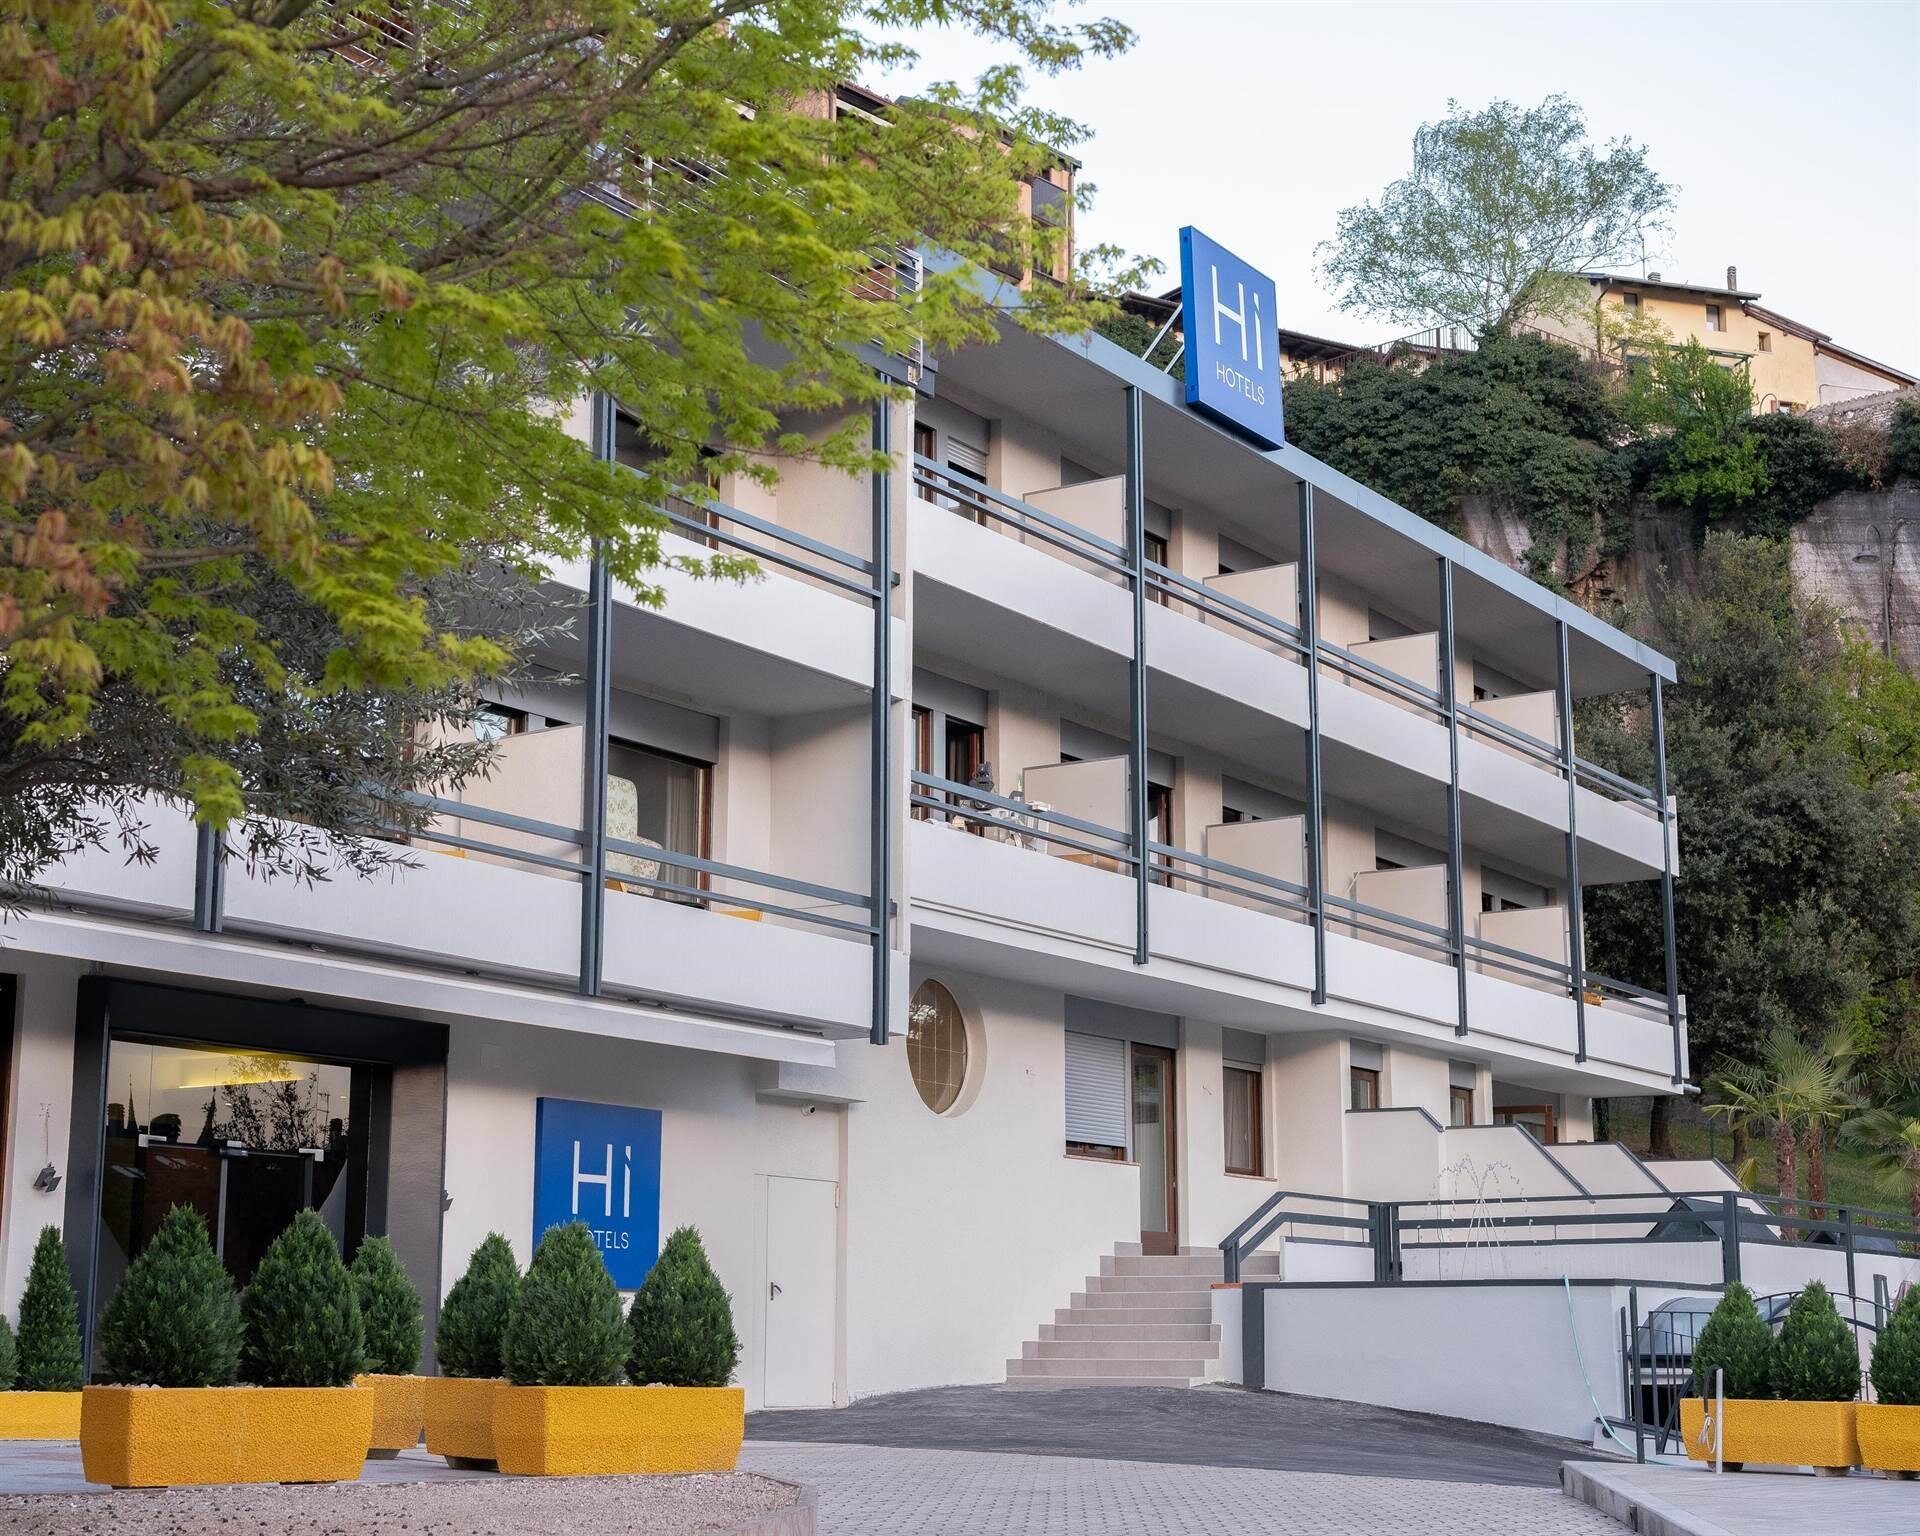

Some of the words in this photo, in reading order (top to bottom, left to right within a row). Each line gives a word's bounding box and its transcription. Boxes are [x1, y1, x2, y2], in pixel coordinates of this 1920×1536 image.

[1211, 264, 1264, 371] Hi
[1216, 360, 1265, 405] HOTELS
[572, 1140, 631, 1218] Hi
[586, 1230, 630, 1249] TELS
